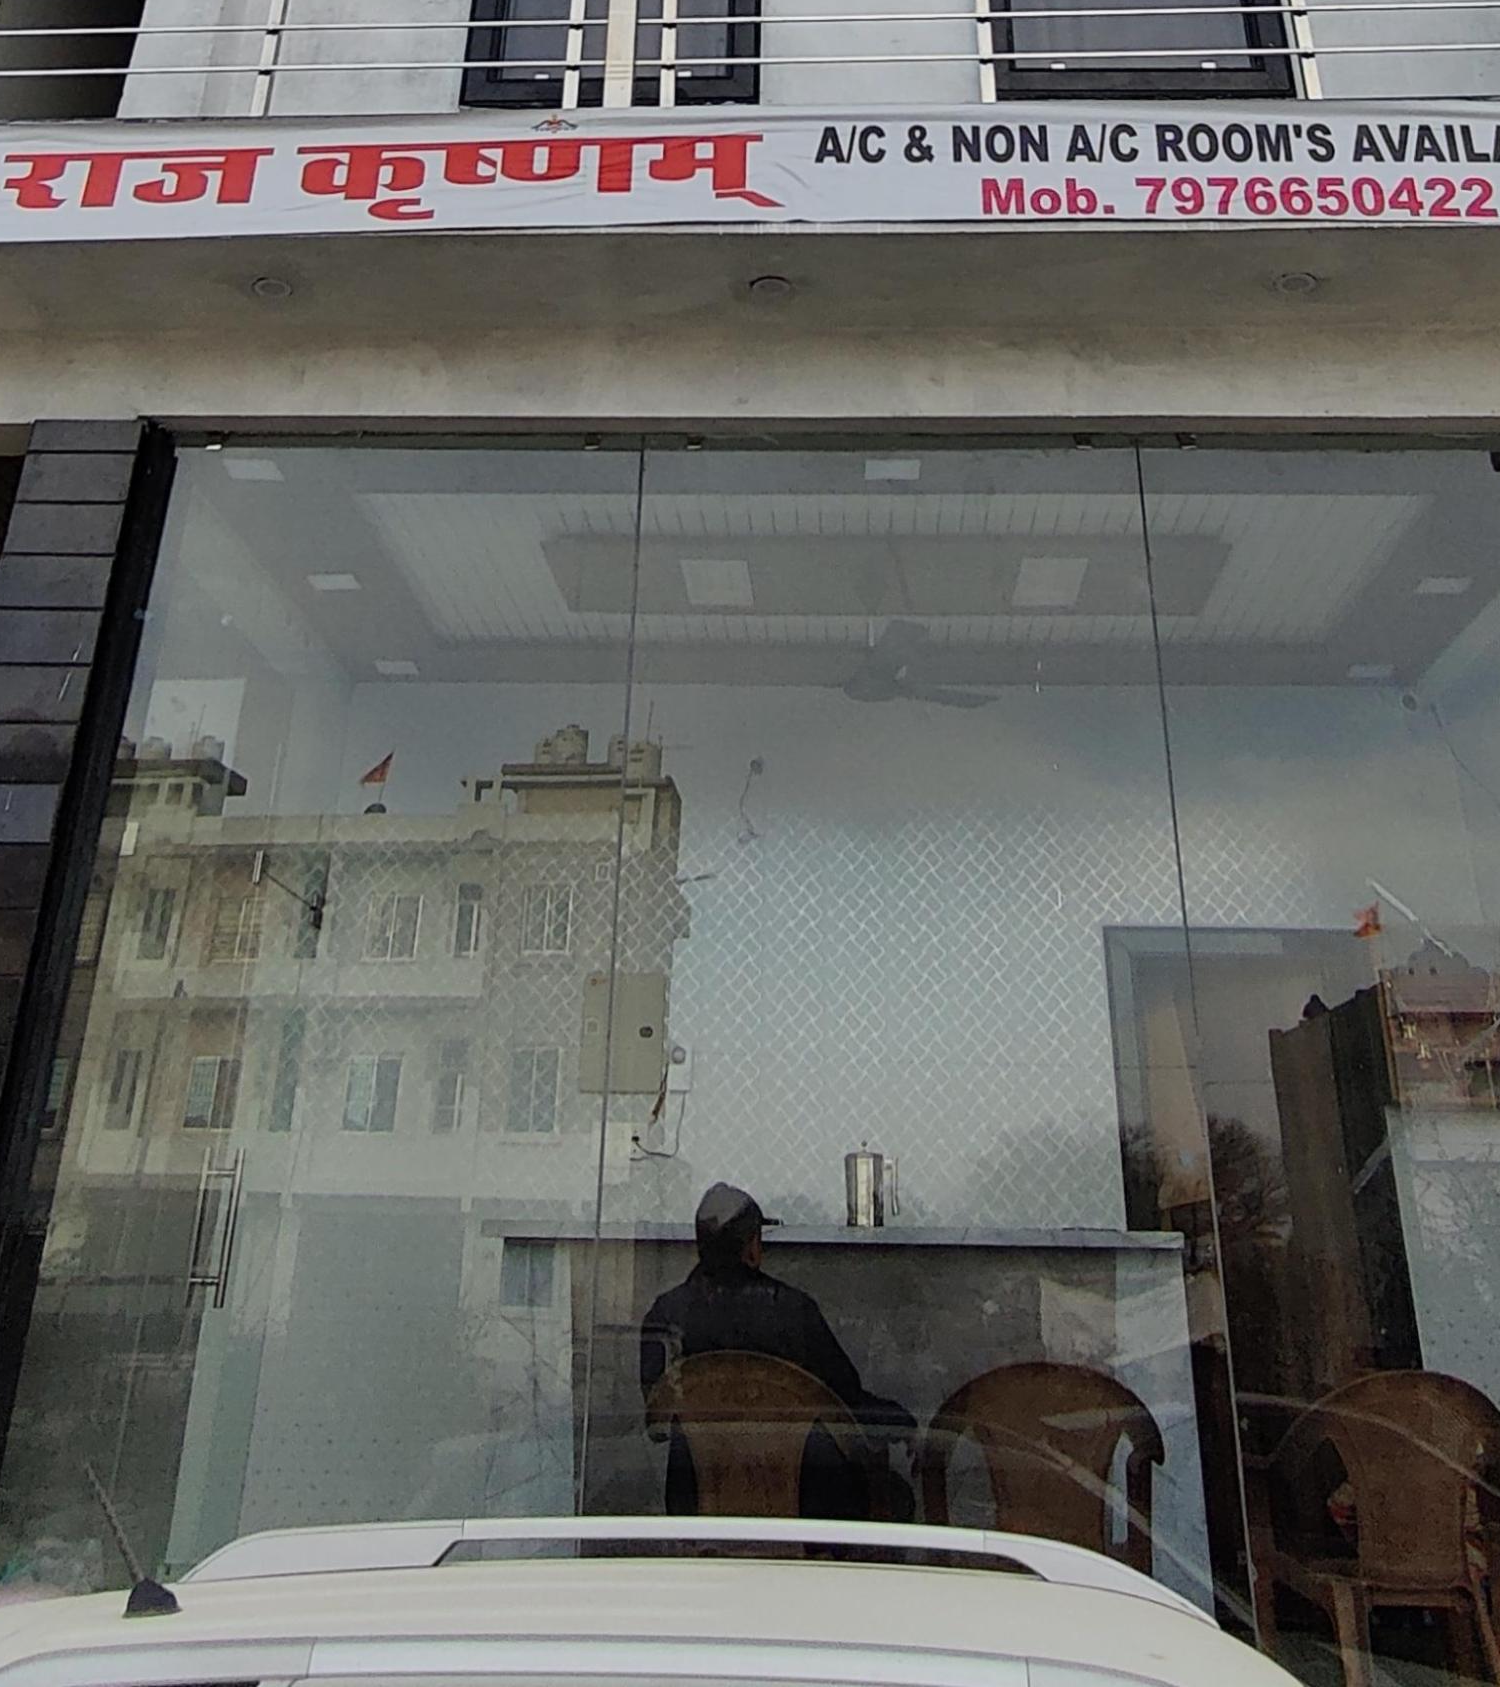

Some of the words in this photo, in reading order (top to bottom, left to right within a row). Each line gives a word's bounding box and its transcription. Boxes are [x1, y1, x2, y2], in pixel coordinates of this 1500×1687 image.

[813, 124, 887, 165] A/C
[903, 124, 936, 164] &
[951, 124, 1050, 164] NON
[1065, 123, 1140, 164] A/C
[1155, 122, 1337, 164] ROOM'S
[4, 146, 274, 210] राज
[297, 133, 786, 221] कृष्णम्
[980, 177, 1114, 216] Mob.
[1135, 176, 1499, 219] 7976650422
